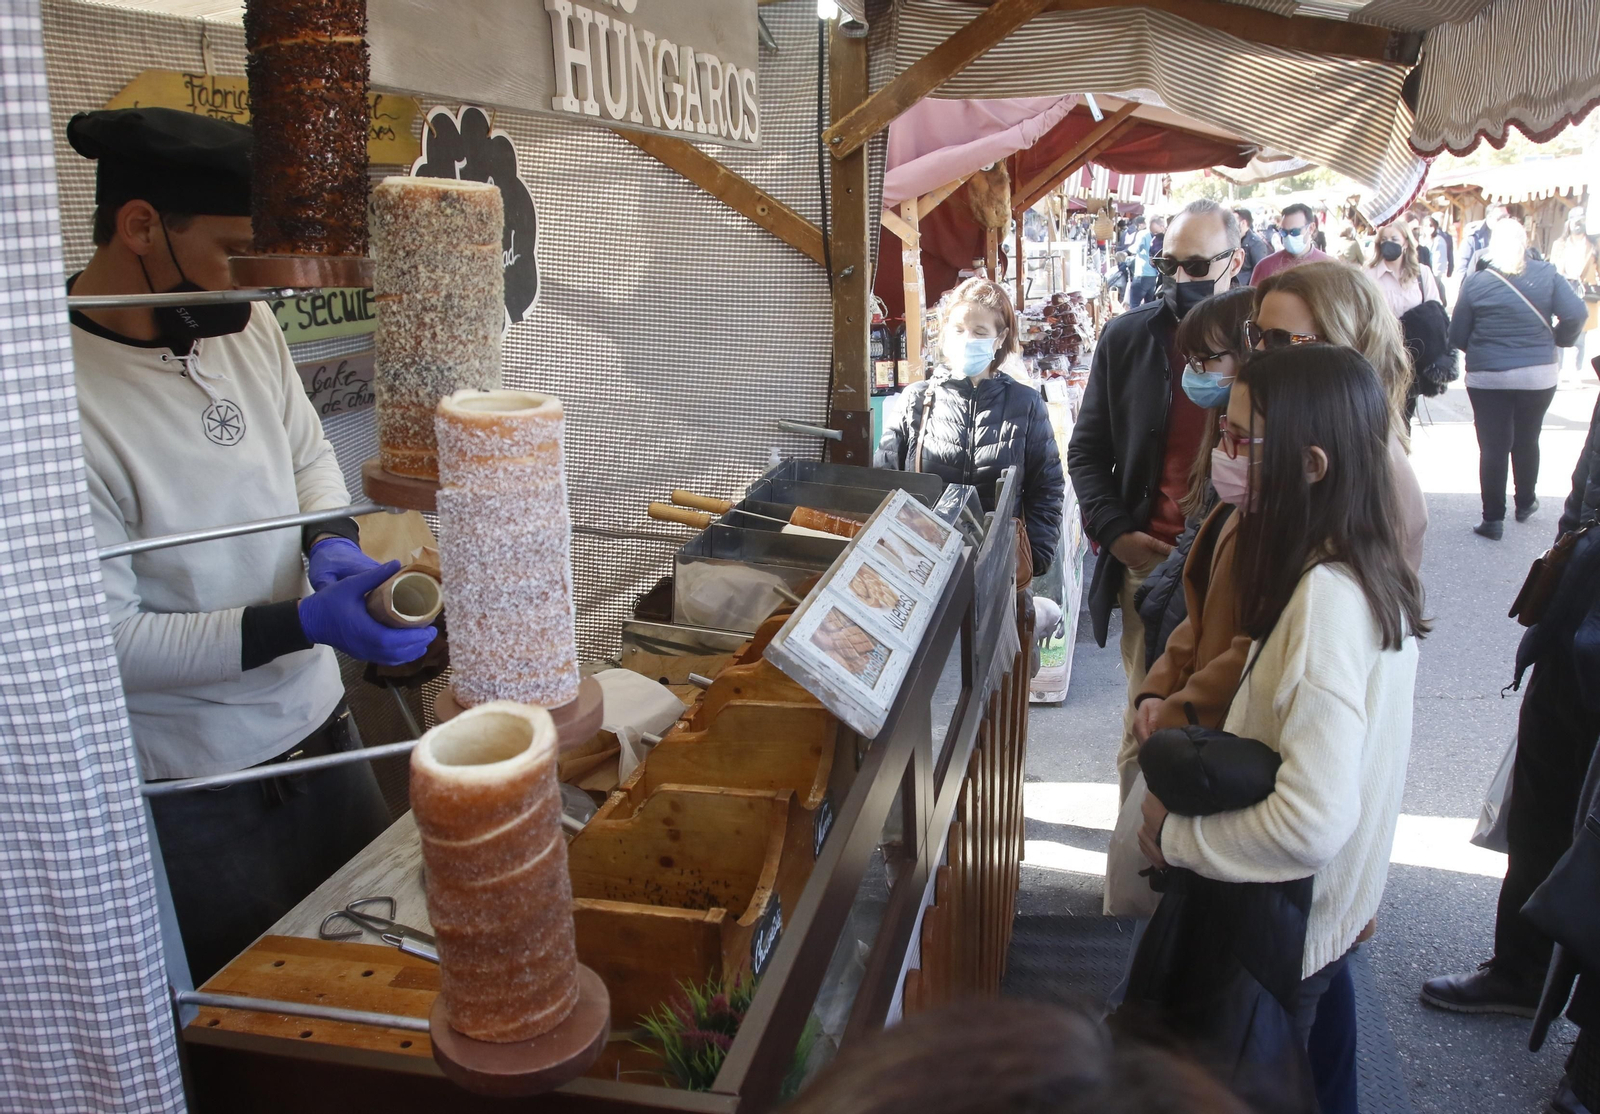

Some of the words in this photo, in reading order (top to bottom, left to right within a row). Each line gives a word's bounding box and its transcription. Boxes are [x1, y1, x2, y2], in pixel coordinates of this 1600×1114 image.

[545, 0, 760, 143] HUNGAROS
[176, 307, 199, 329] STAFF
[908, 560, 932, 586] Coco
[854, 643, 890, 689] hocolate
